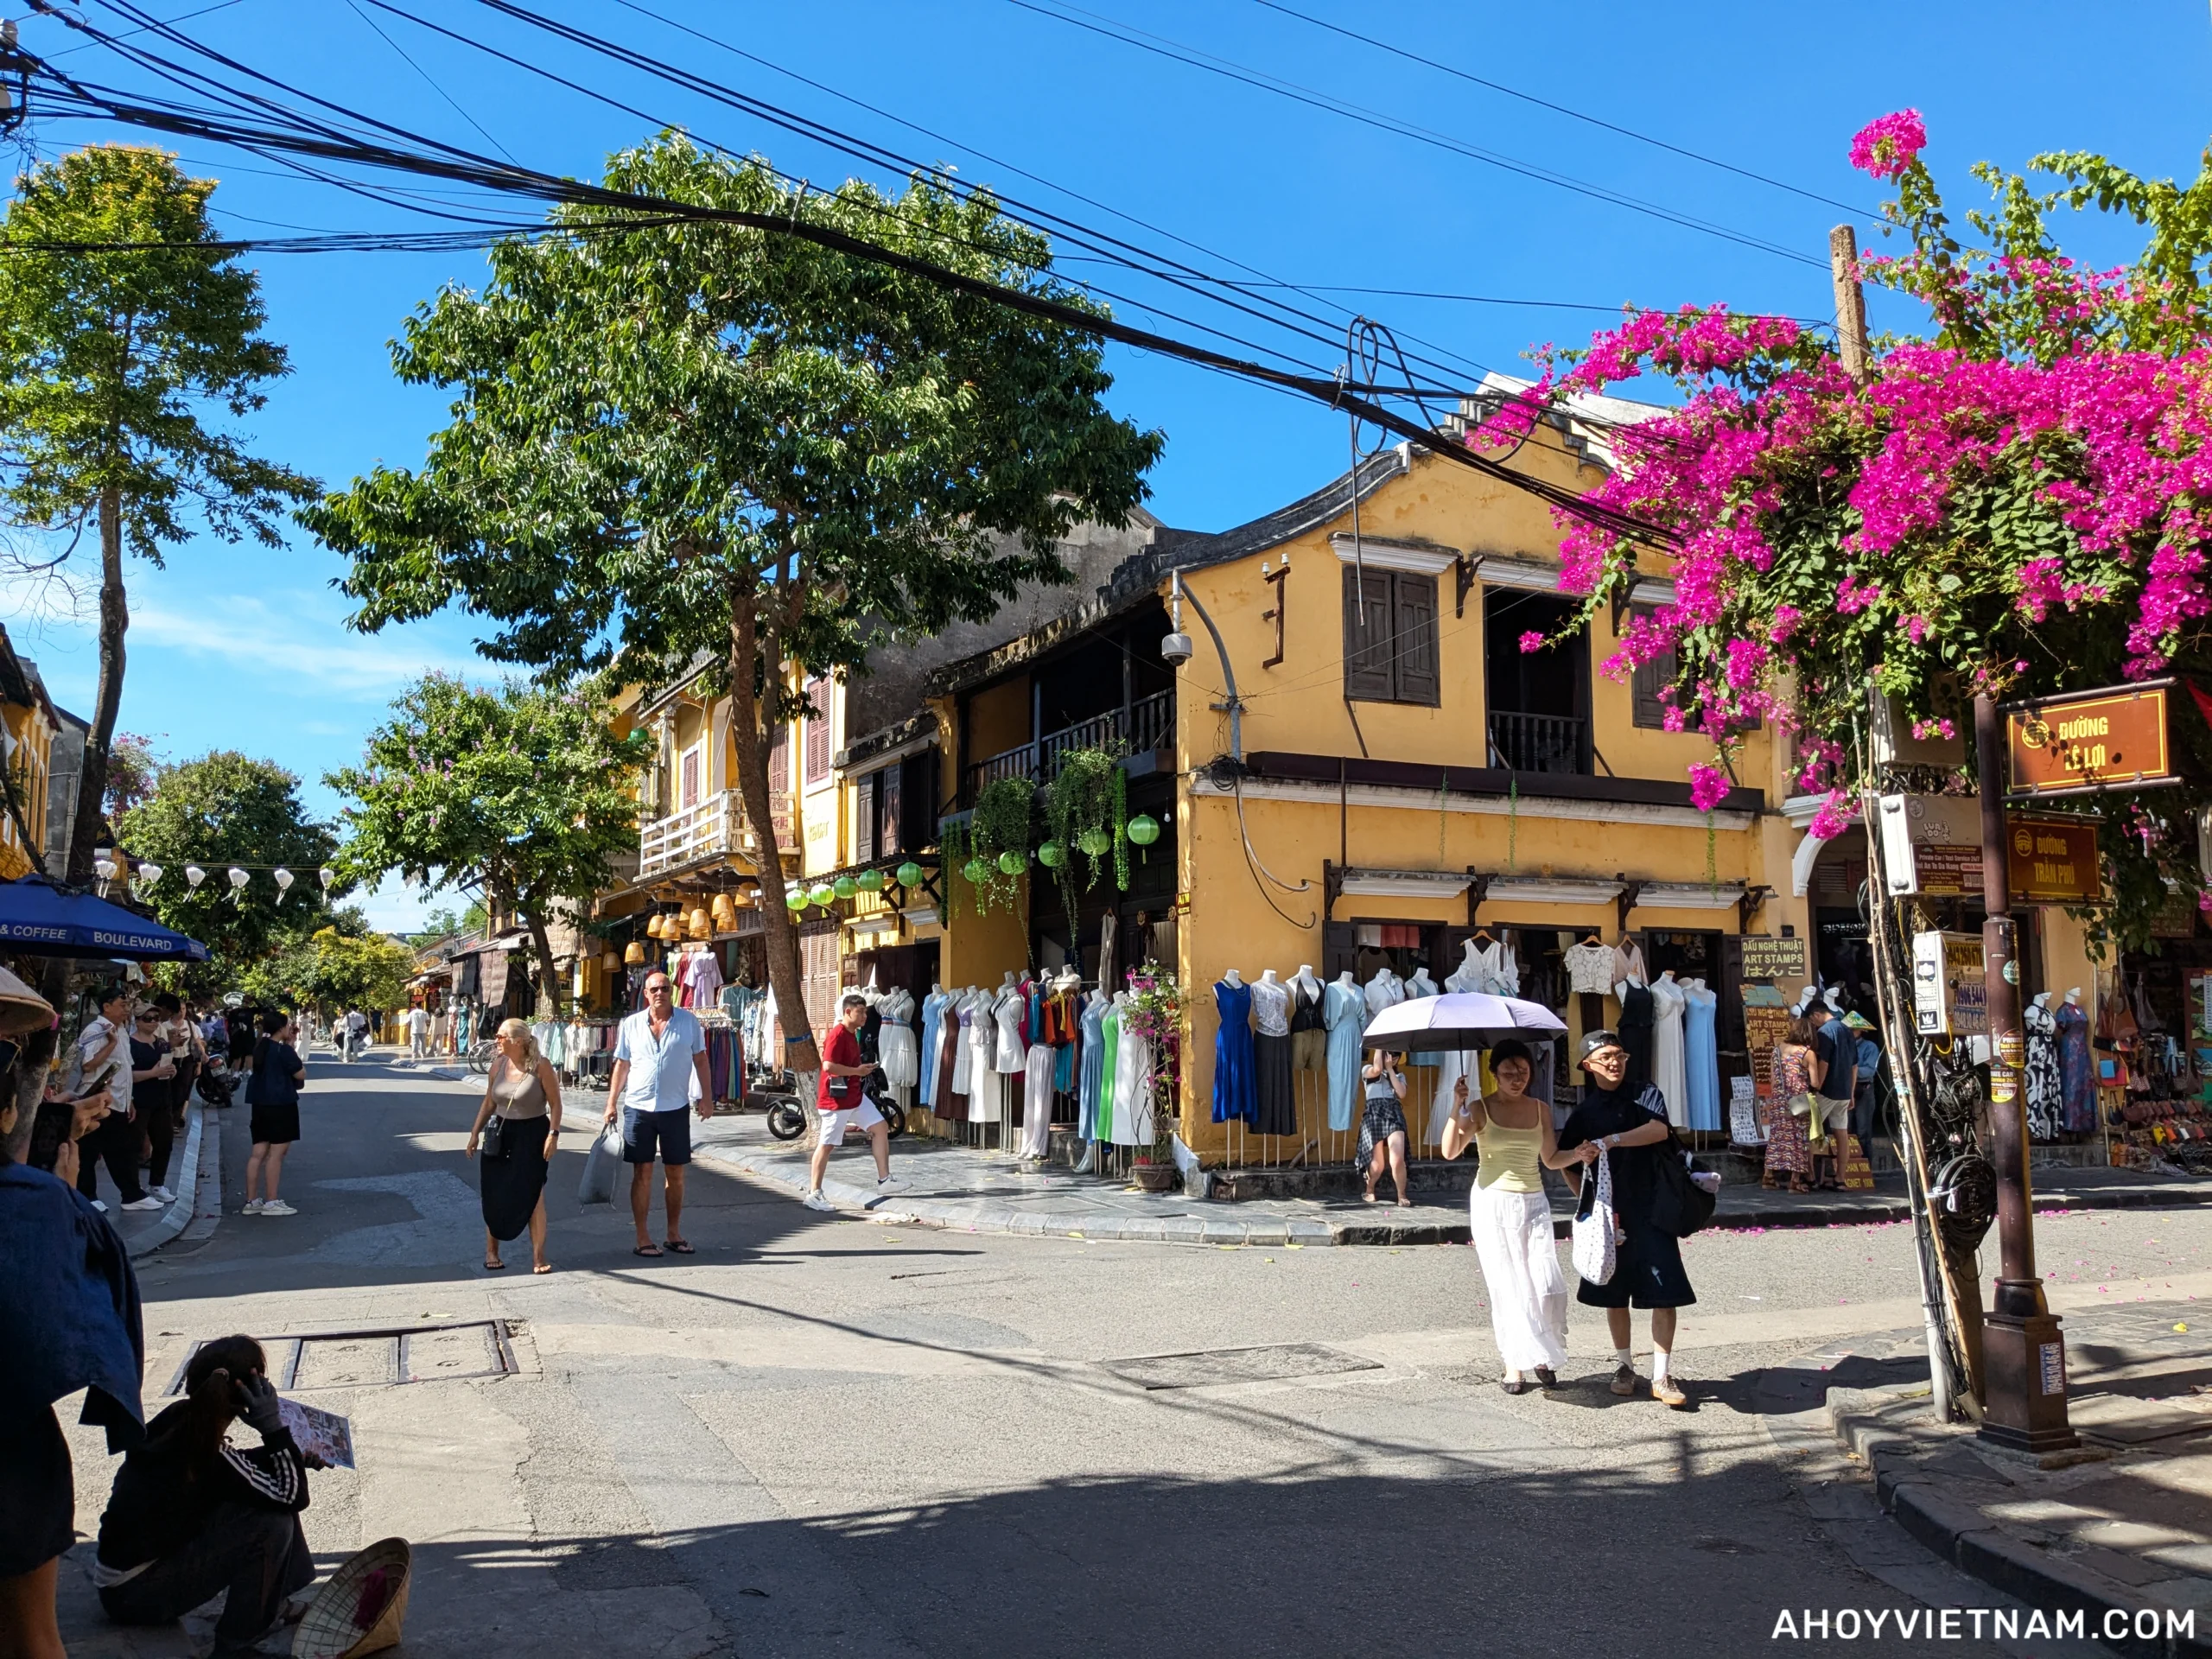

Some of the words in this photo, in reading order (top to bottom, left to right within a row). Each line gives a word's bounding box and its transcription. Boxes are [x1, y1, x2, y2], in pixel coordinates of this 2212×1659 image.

[2058, 715, 2108, 741] ĐƯỜNG
[2084, 743, 2106, 771] LỢI
[2037, 833, 2067, 855] ĐƯỜNG
[2034, 856, 2056, 883] TRẦN
[2058, 861, 2075, 885] PHÚ
[0, 924, 9, 935] &
[13, 925, 67, 939] COFFEE
[93, 931, 172, 950] BOULEVARD
[1743, 940, 1758, 951] DẤU
[1758, 940, 1777, 952] NGHỆ
[1778, 939, 1802, 952] THUẬT
[1745, 955, 1762, 963] ART
[1764, 954, 1803, 963] STAMPS
[1745, 966, 1804, 976] はんこ
[1749, 1020, 1762, 1028] ART
[1764, 1020, 1790, 1029] STAMPS
